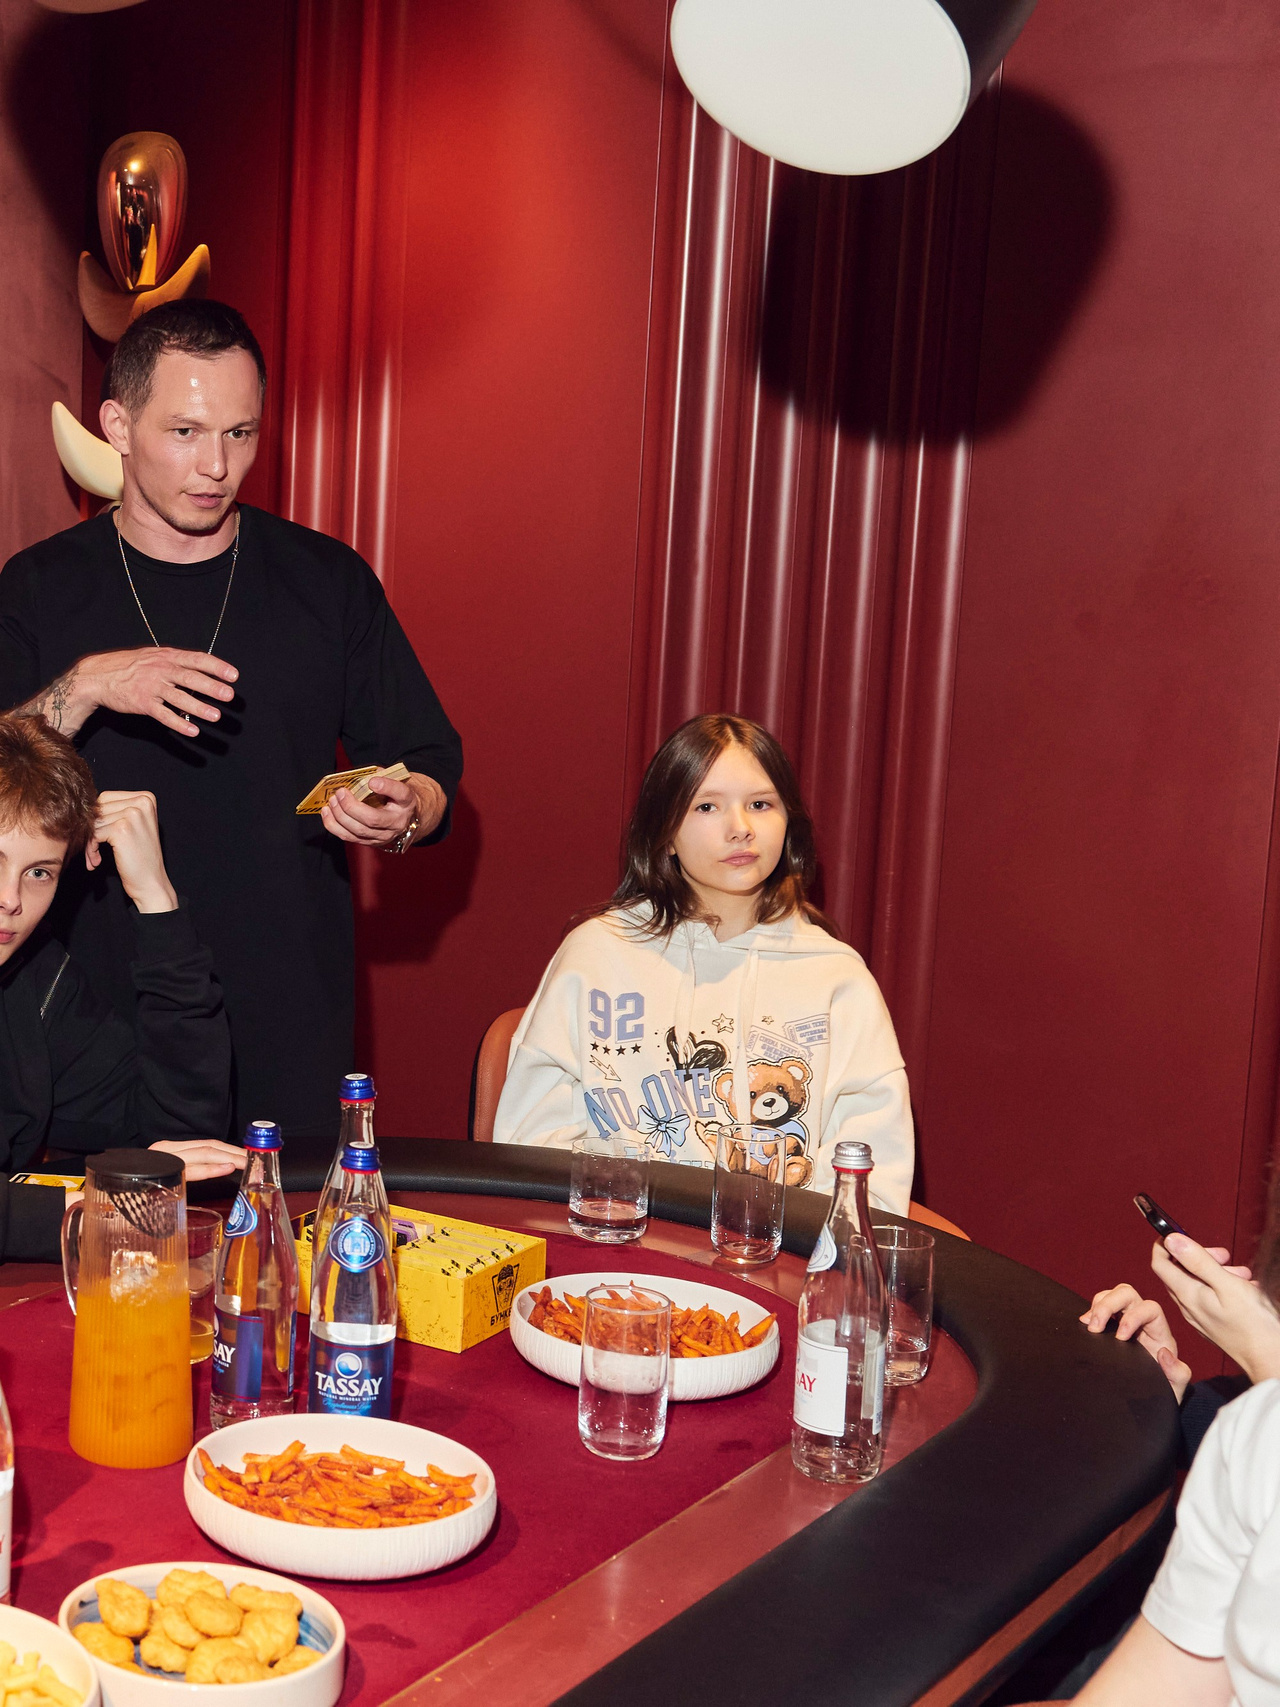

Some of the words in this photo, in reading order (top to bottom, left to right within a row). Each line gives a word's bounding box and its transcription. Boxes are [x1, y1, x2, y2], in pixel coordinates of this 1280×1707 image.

[588, 988, 645, 1044] 92
[584, 1087, 638, 1140] NO
[641, 1067, 716, 1121] ONE
[490, 1307, 512, 1326] БУНКЕ
[315, 1371, 383, 1397] TASSAY
